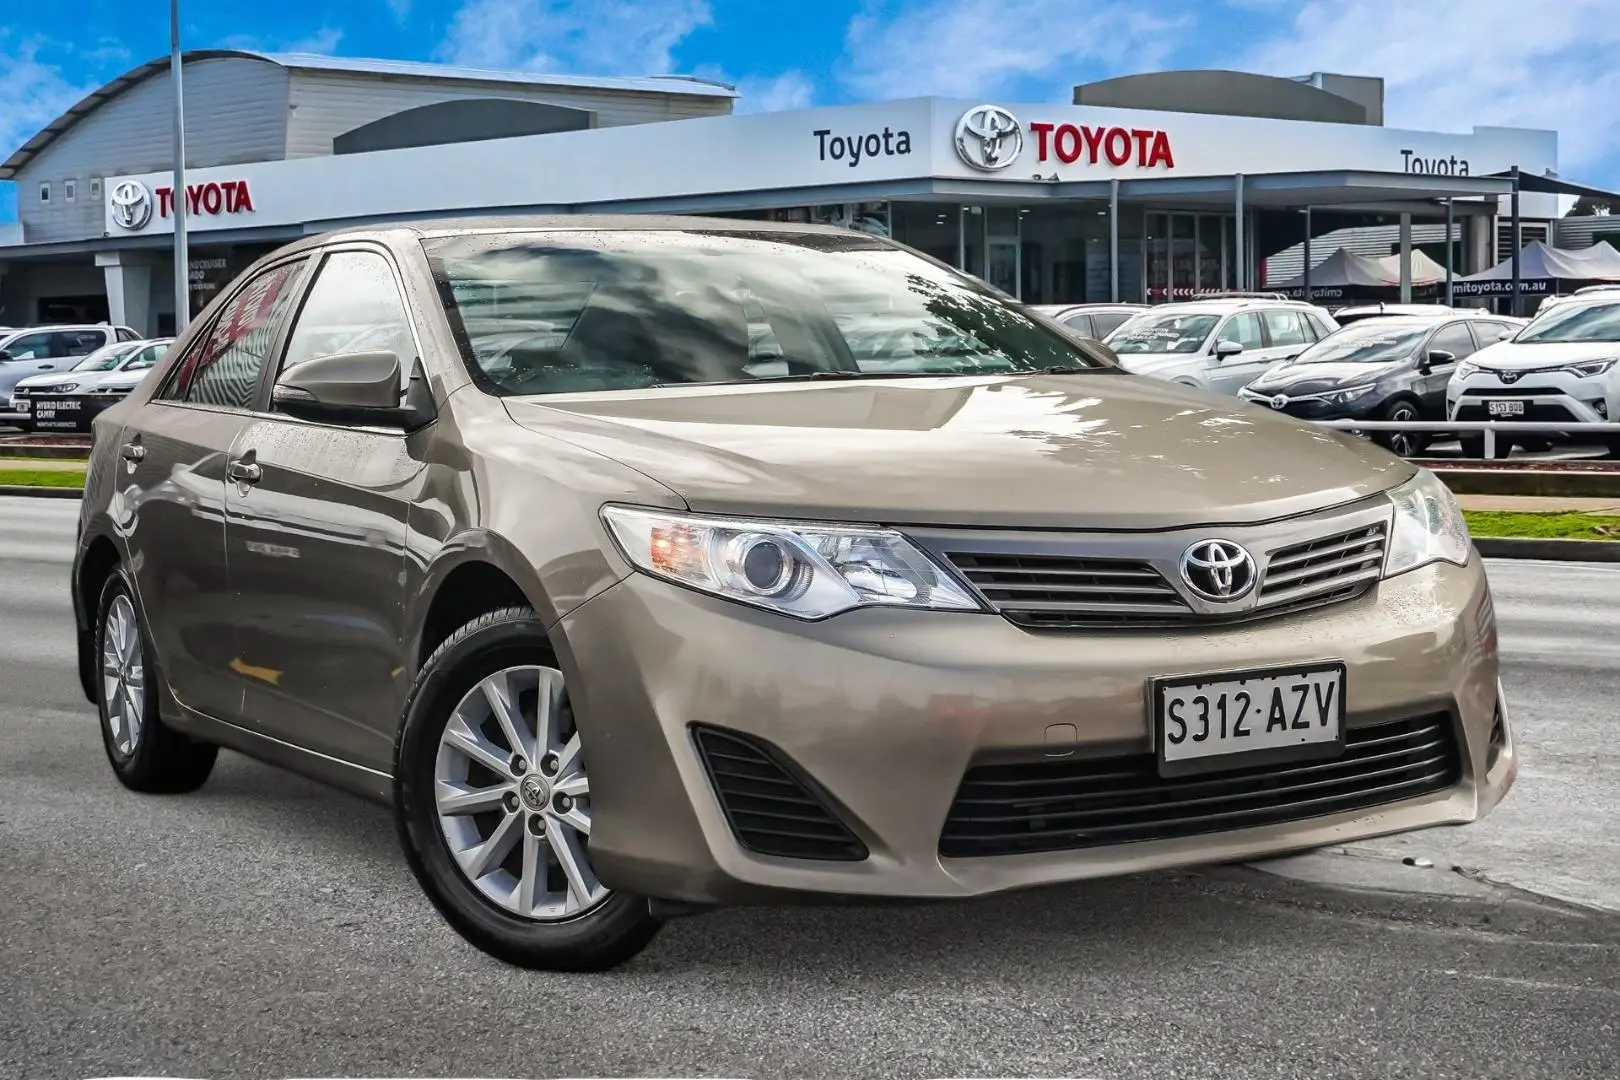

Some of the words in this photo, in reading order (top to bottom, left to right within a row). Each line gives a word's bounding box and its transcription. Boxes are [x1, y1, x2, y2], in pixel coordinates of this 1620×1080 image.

[813, 126, 912, 168] Toyota
[1030, 121, 1175, 169] TOYOTA
[1453, 280, 1546, 295] mitoyota.cm.au
